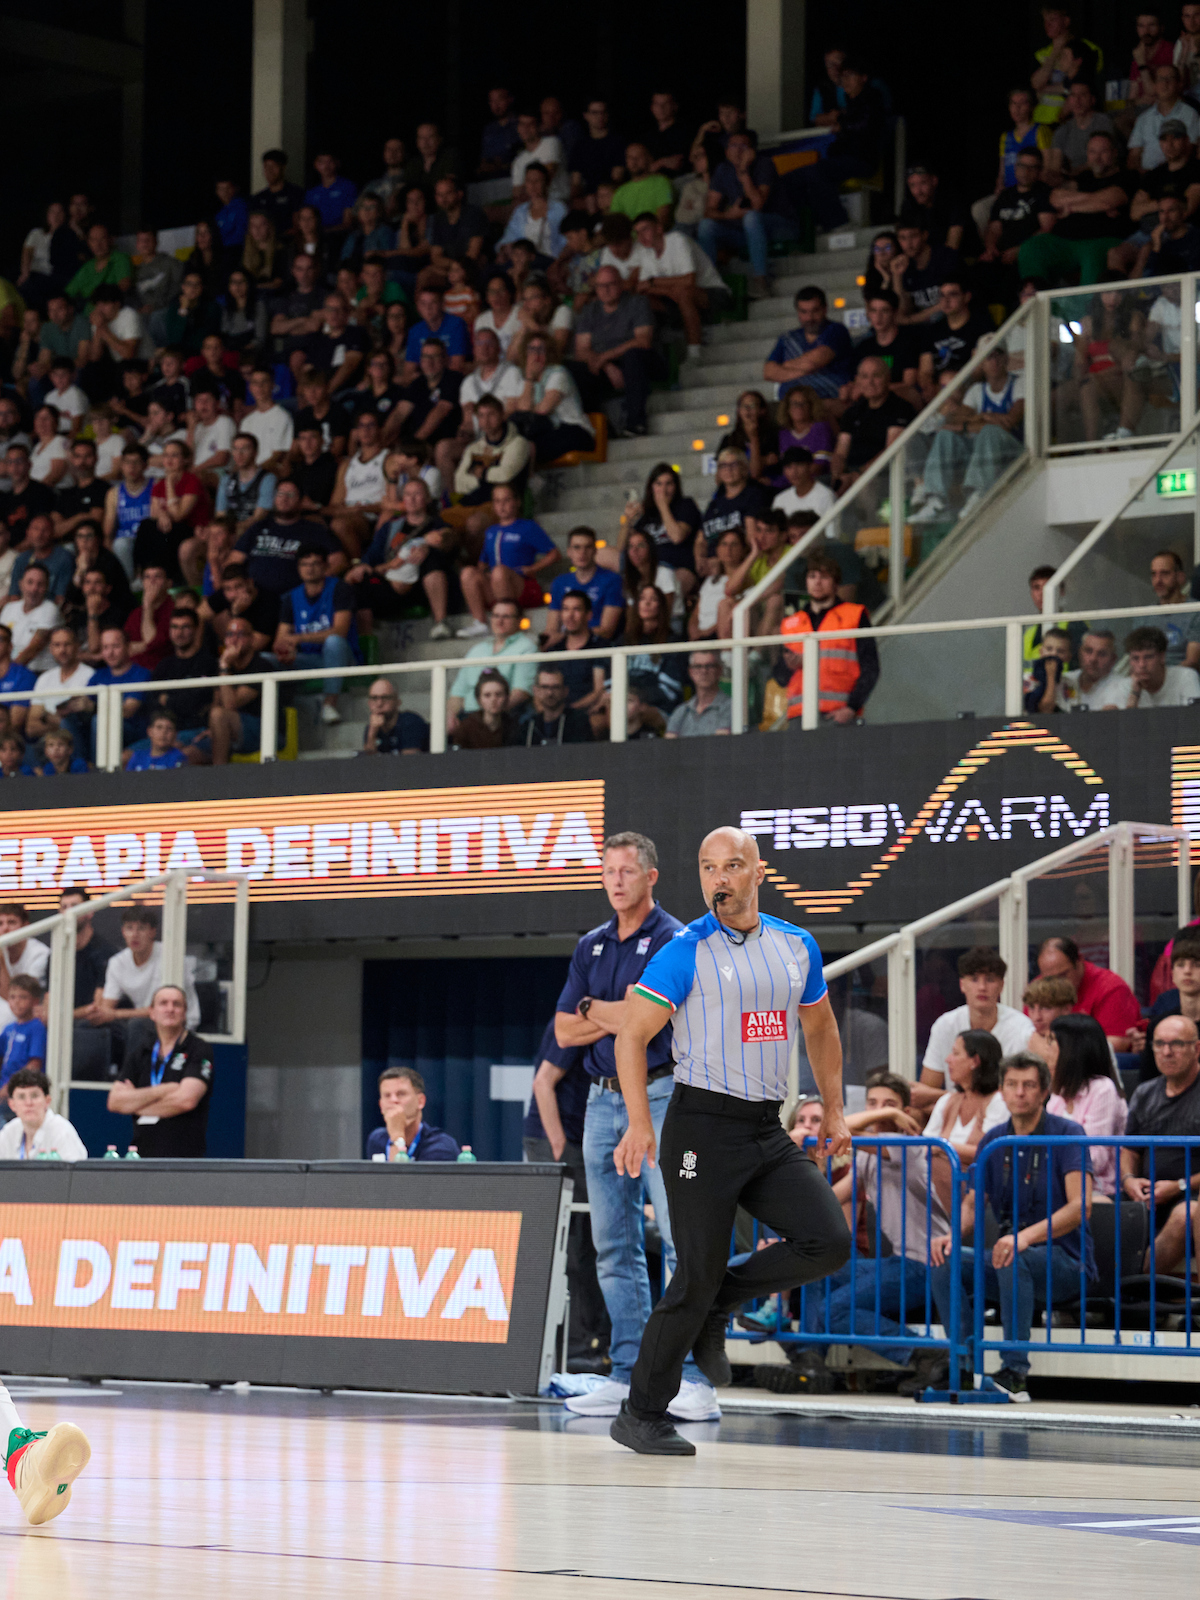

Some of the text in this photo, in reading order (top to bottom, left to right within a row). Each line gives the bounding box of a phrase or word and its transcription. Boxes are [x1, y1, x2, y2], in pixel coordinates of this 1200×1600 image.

[740, 793, 1110, 850] FISIOWARM
[226, 811, 602, 881] DEFINITIVA
[747, 1026, 784, 1037] GROUP
[748, 1011, 783, 1027] ATTAL
[679, 1169, 697, 1179] FIP
[54, 1239, 511, 1321] DEFINITIVA
